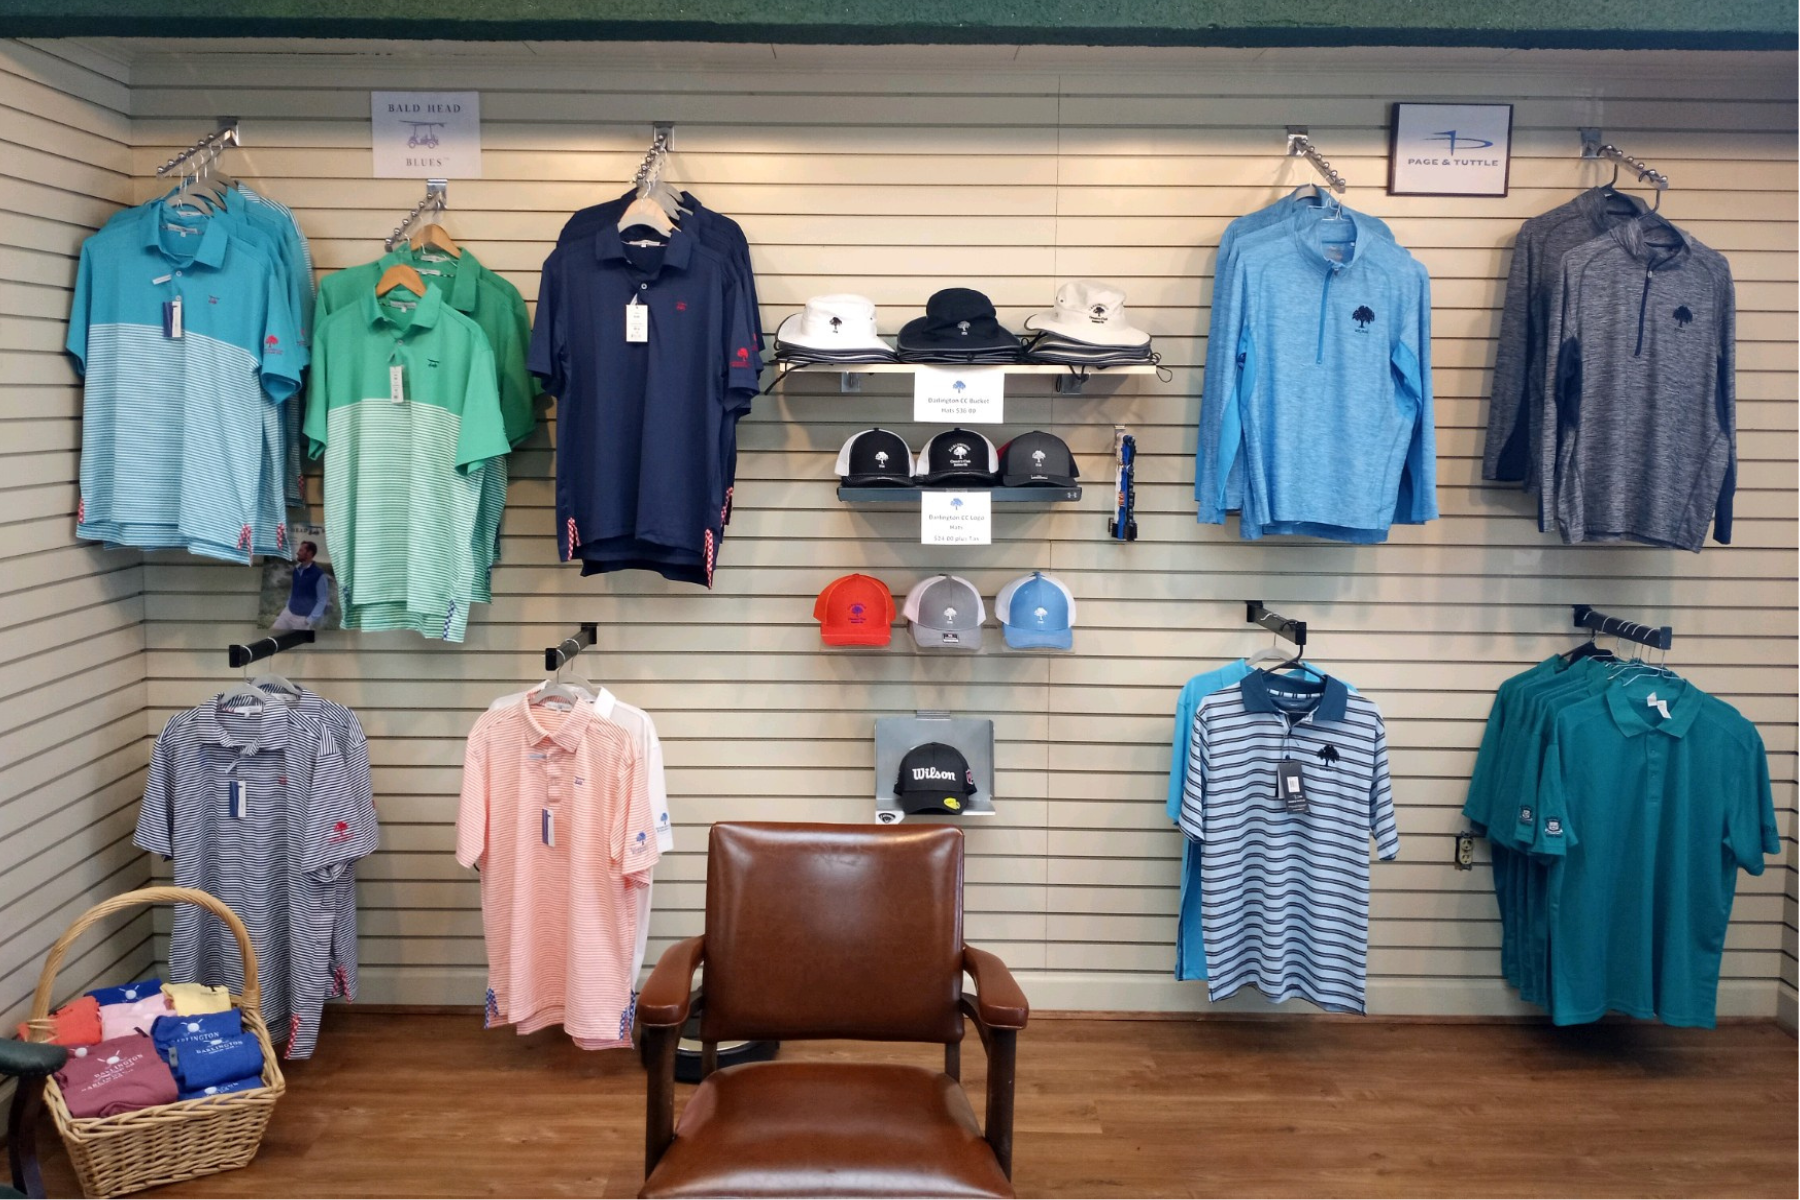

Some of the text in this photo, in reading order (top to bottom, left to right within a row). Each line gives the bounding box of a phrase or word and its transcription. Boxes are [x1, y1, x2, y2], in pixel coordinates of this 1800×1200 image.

[388, 104, 461, 113] BALD HEAD
[912, 766, 956, 781] Wilson
[195, 1040, 244, 1054] DARLINGTON
[94, 1053, 144, 1079] DARLINGTON
